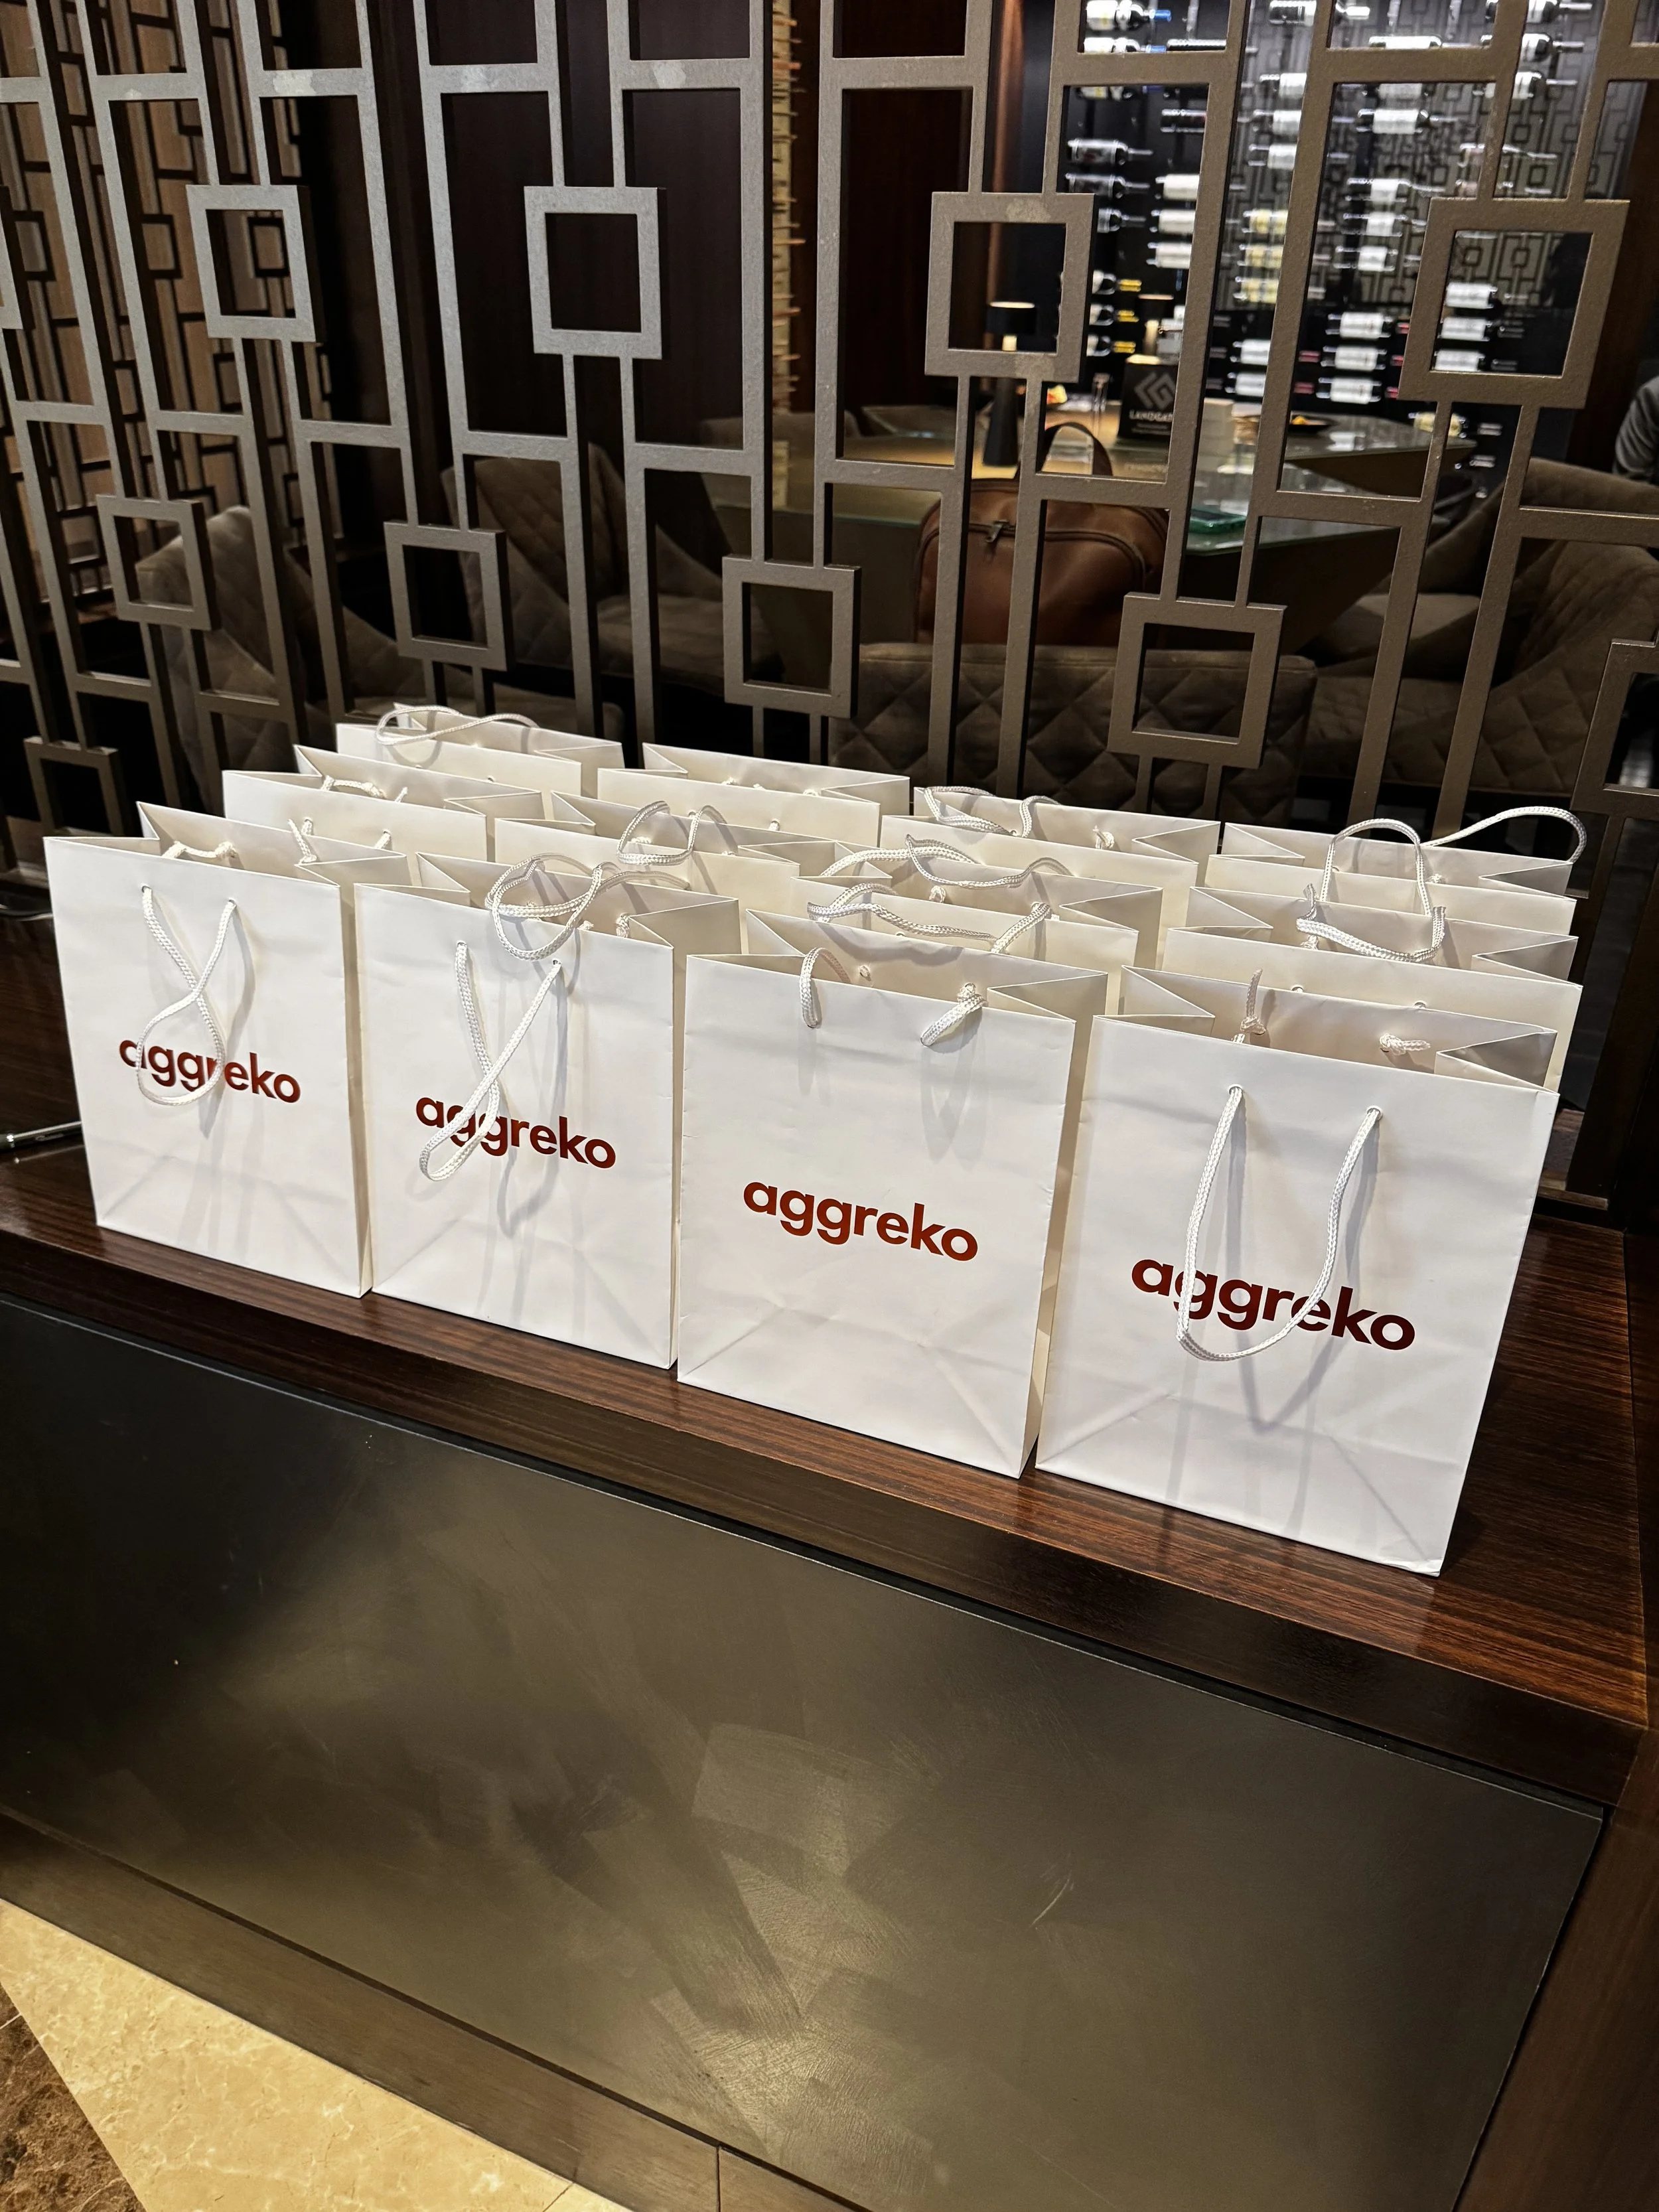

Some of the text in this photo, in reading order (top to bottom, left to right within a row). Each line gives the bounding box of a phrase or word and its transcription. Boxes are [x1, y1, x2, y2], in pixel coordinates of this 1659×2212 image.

[119, 1039, 301, 1104] aggreko
[415, 1097, 616, 1169] aggreko
[743, 1181, 979, 1262] aggreko
[1131, 1259, 1415, 1351] aggreko
